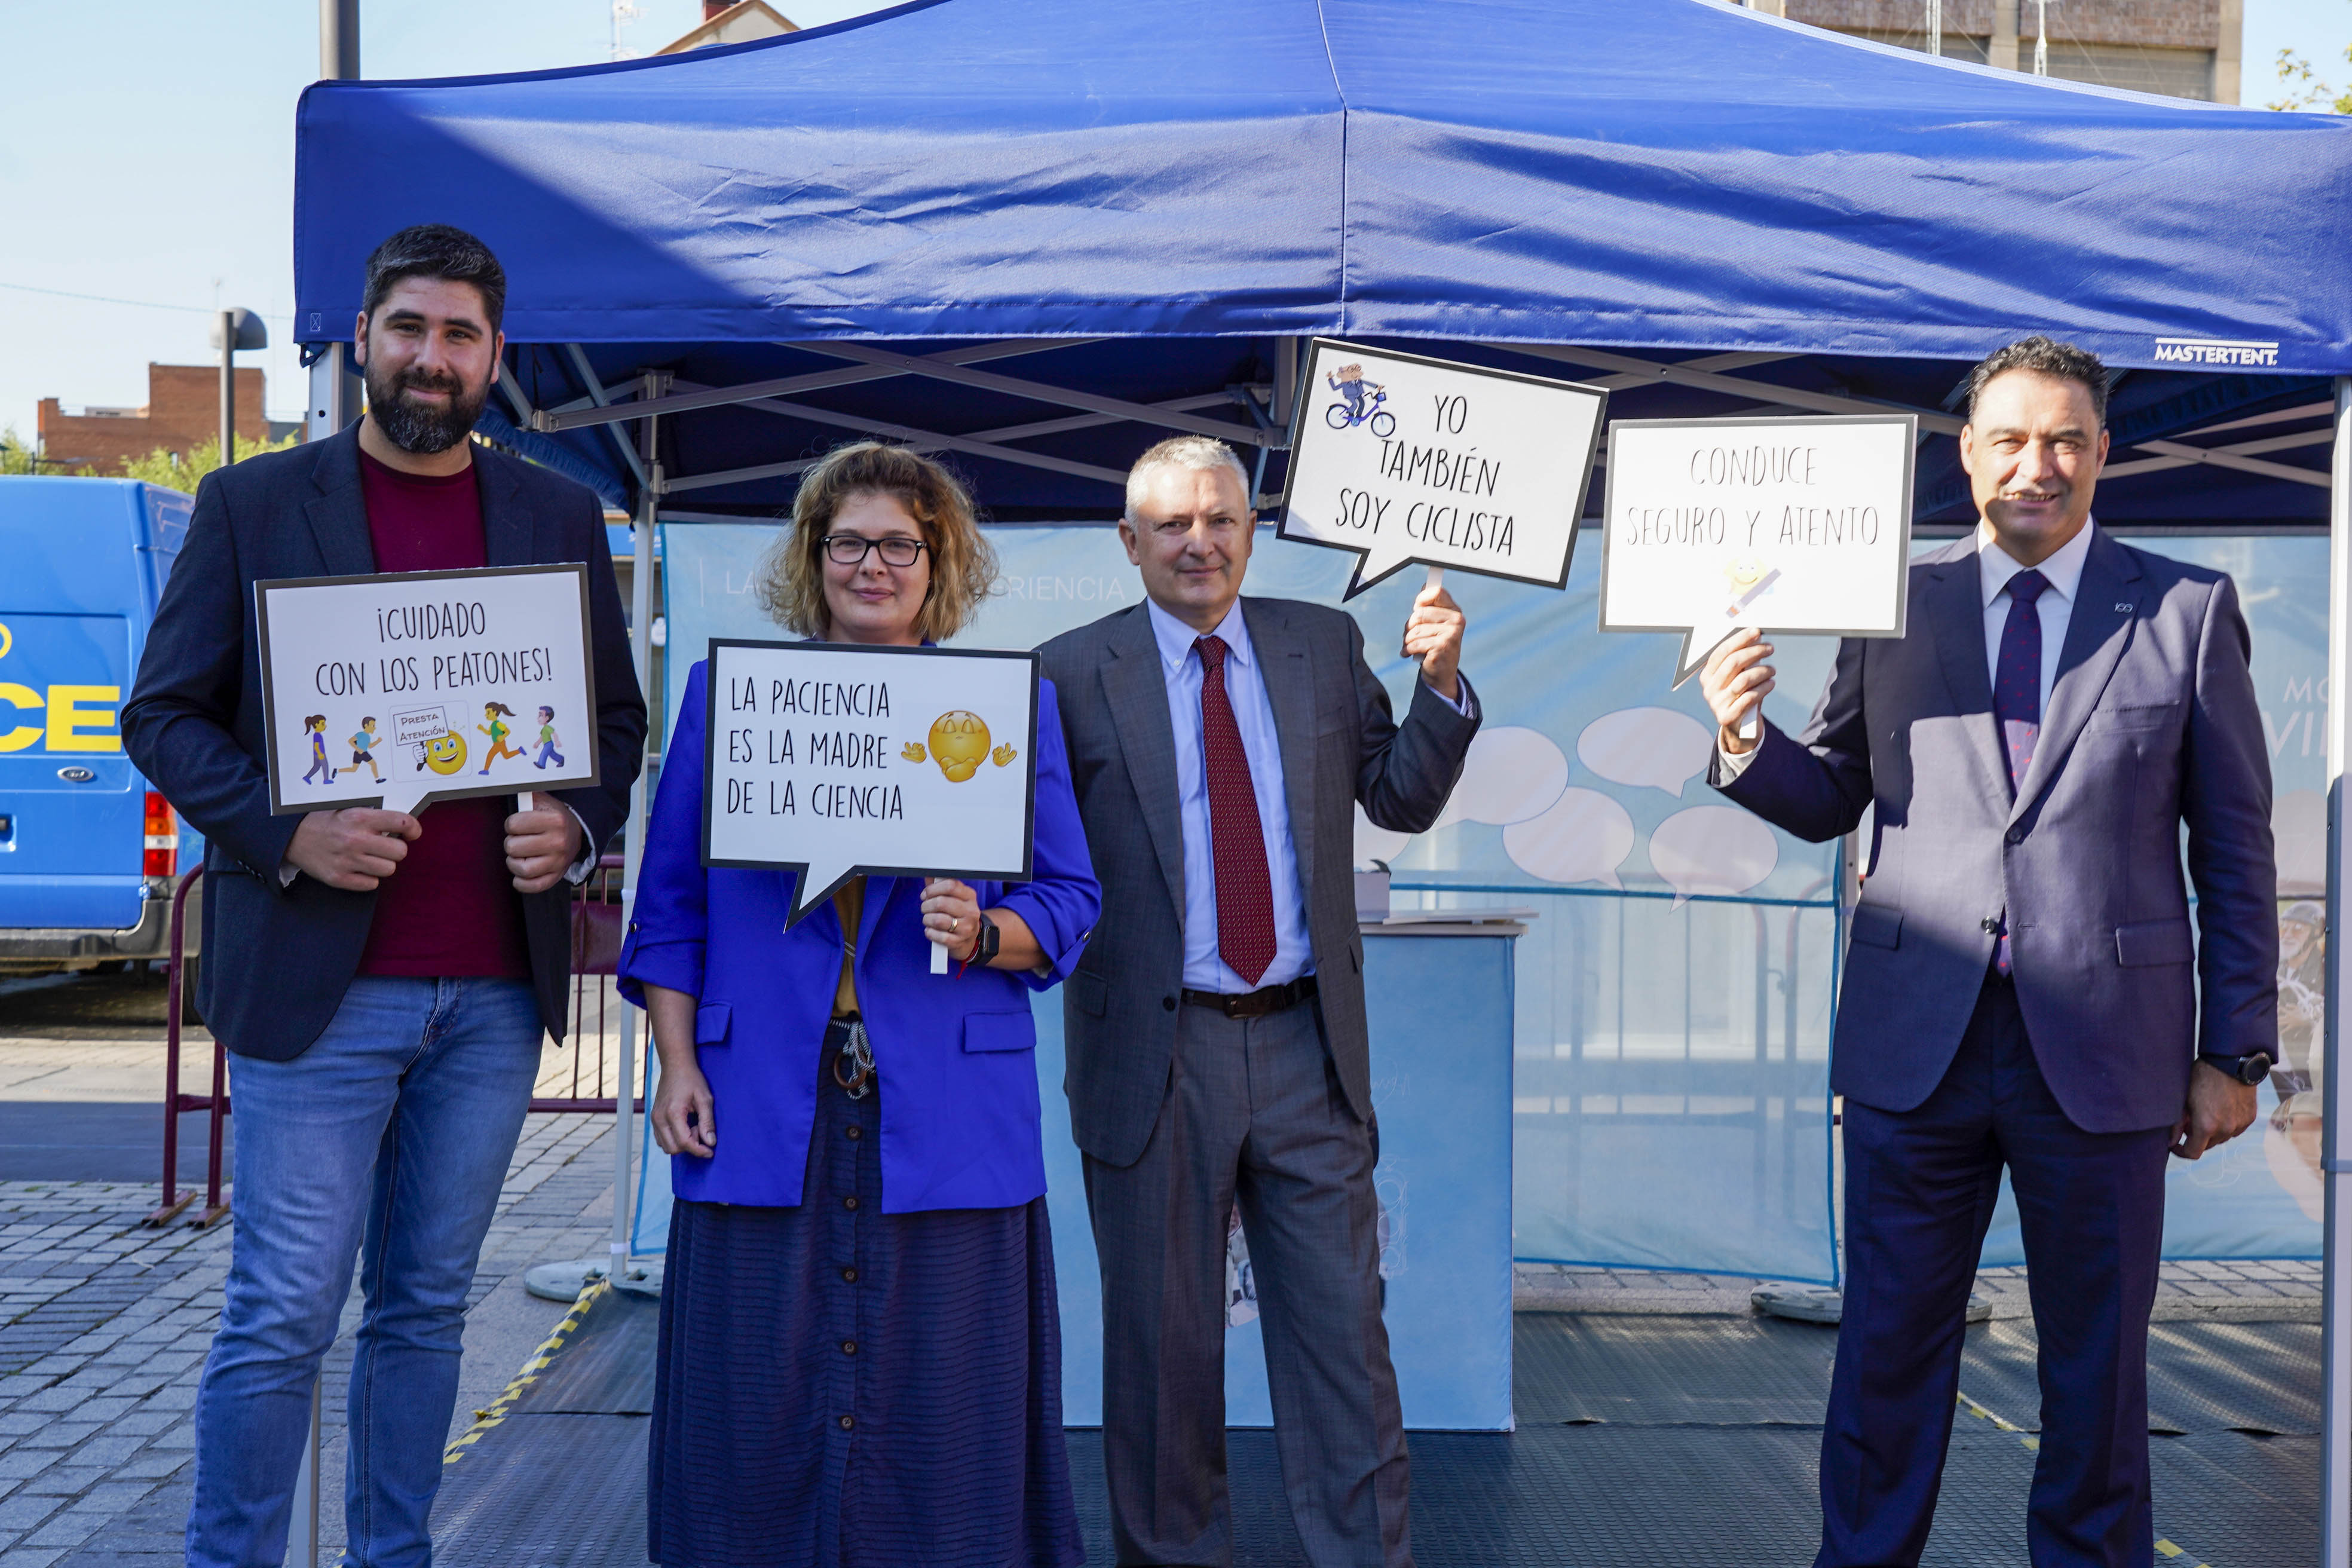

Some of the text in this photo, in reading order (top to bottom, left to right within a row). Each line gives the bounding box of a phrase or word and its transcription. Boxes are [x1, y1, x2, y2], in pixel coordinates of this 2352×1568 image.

[1434, 394, 1468, 435] YO
[1380, 439, 1501, 498] TAMBIÉN
[1690, 445, 1817, 487] CONDUCE
[1336, 487, 1514, 557] SOY CICLISTA
[1627, 504, 1878, 548] SEGURO Y ATENTO
[377, 602, 486, 644] ¡CUIDADO
[316, 647, 553, 696] CON LOS PEATONES!
[731, 676, 890, 718] LA PACIENCIA
[729, 728, 889, 770] ES LA MADRE
[727, 777, 903, 821] DE LA CIENCIA
